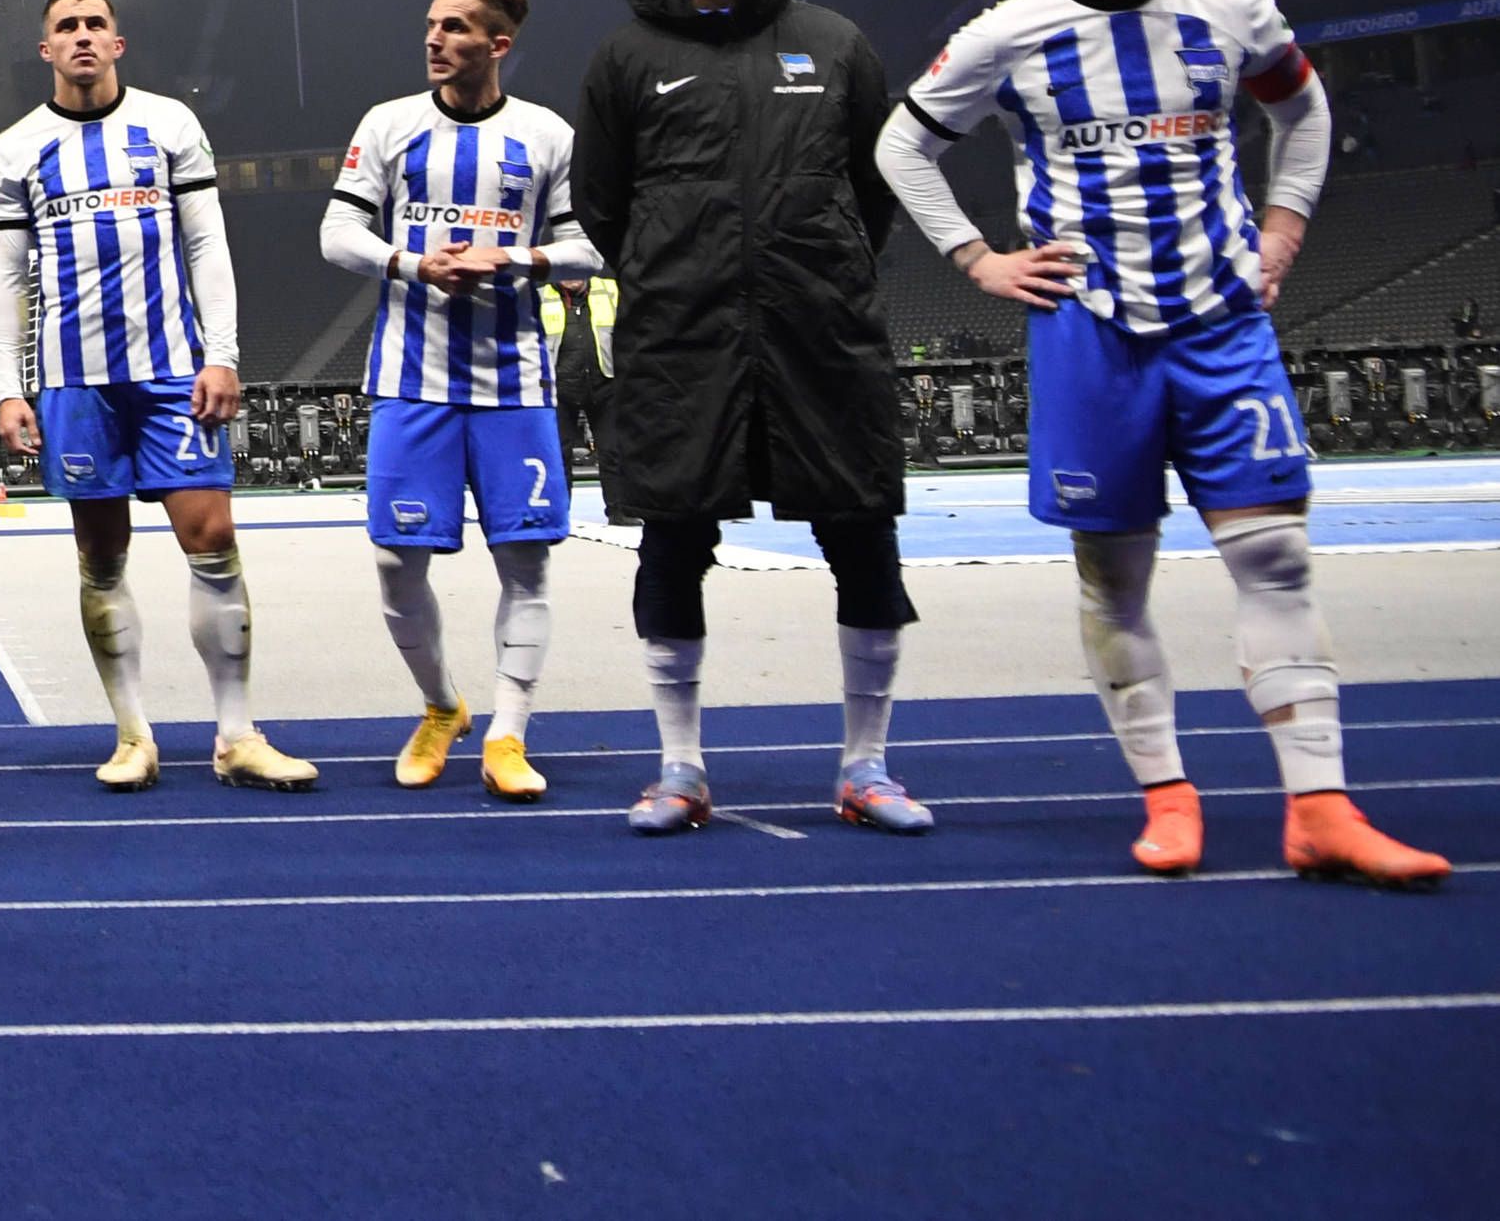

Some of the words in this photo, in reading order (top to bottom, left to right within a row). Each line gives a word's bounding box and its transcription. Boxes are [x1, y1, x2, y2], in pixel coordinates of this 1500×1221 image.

[1322, 10, 1419, 38] AUTOHERO
[46, 188, 161, 220] AUTOHERO
[401, 205, 524, 229] AUTOHERO
[171, 415, 220, 461] 20
[1231, 393, 1307, 461] 21
[523, 457, 550, 507] 2
